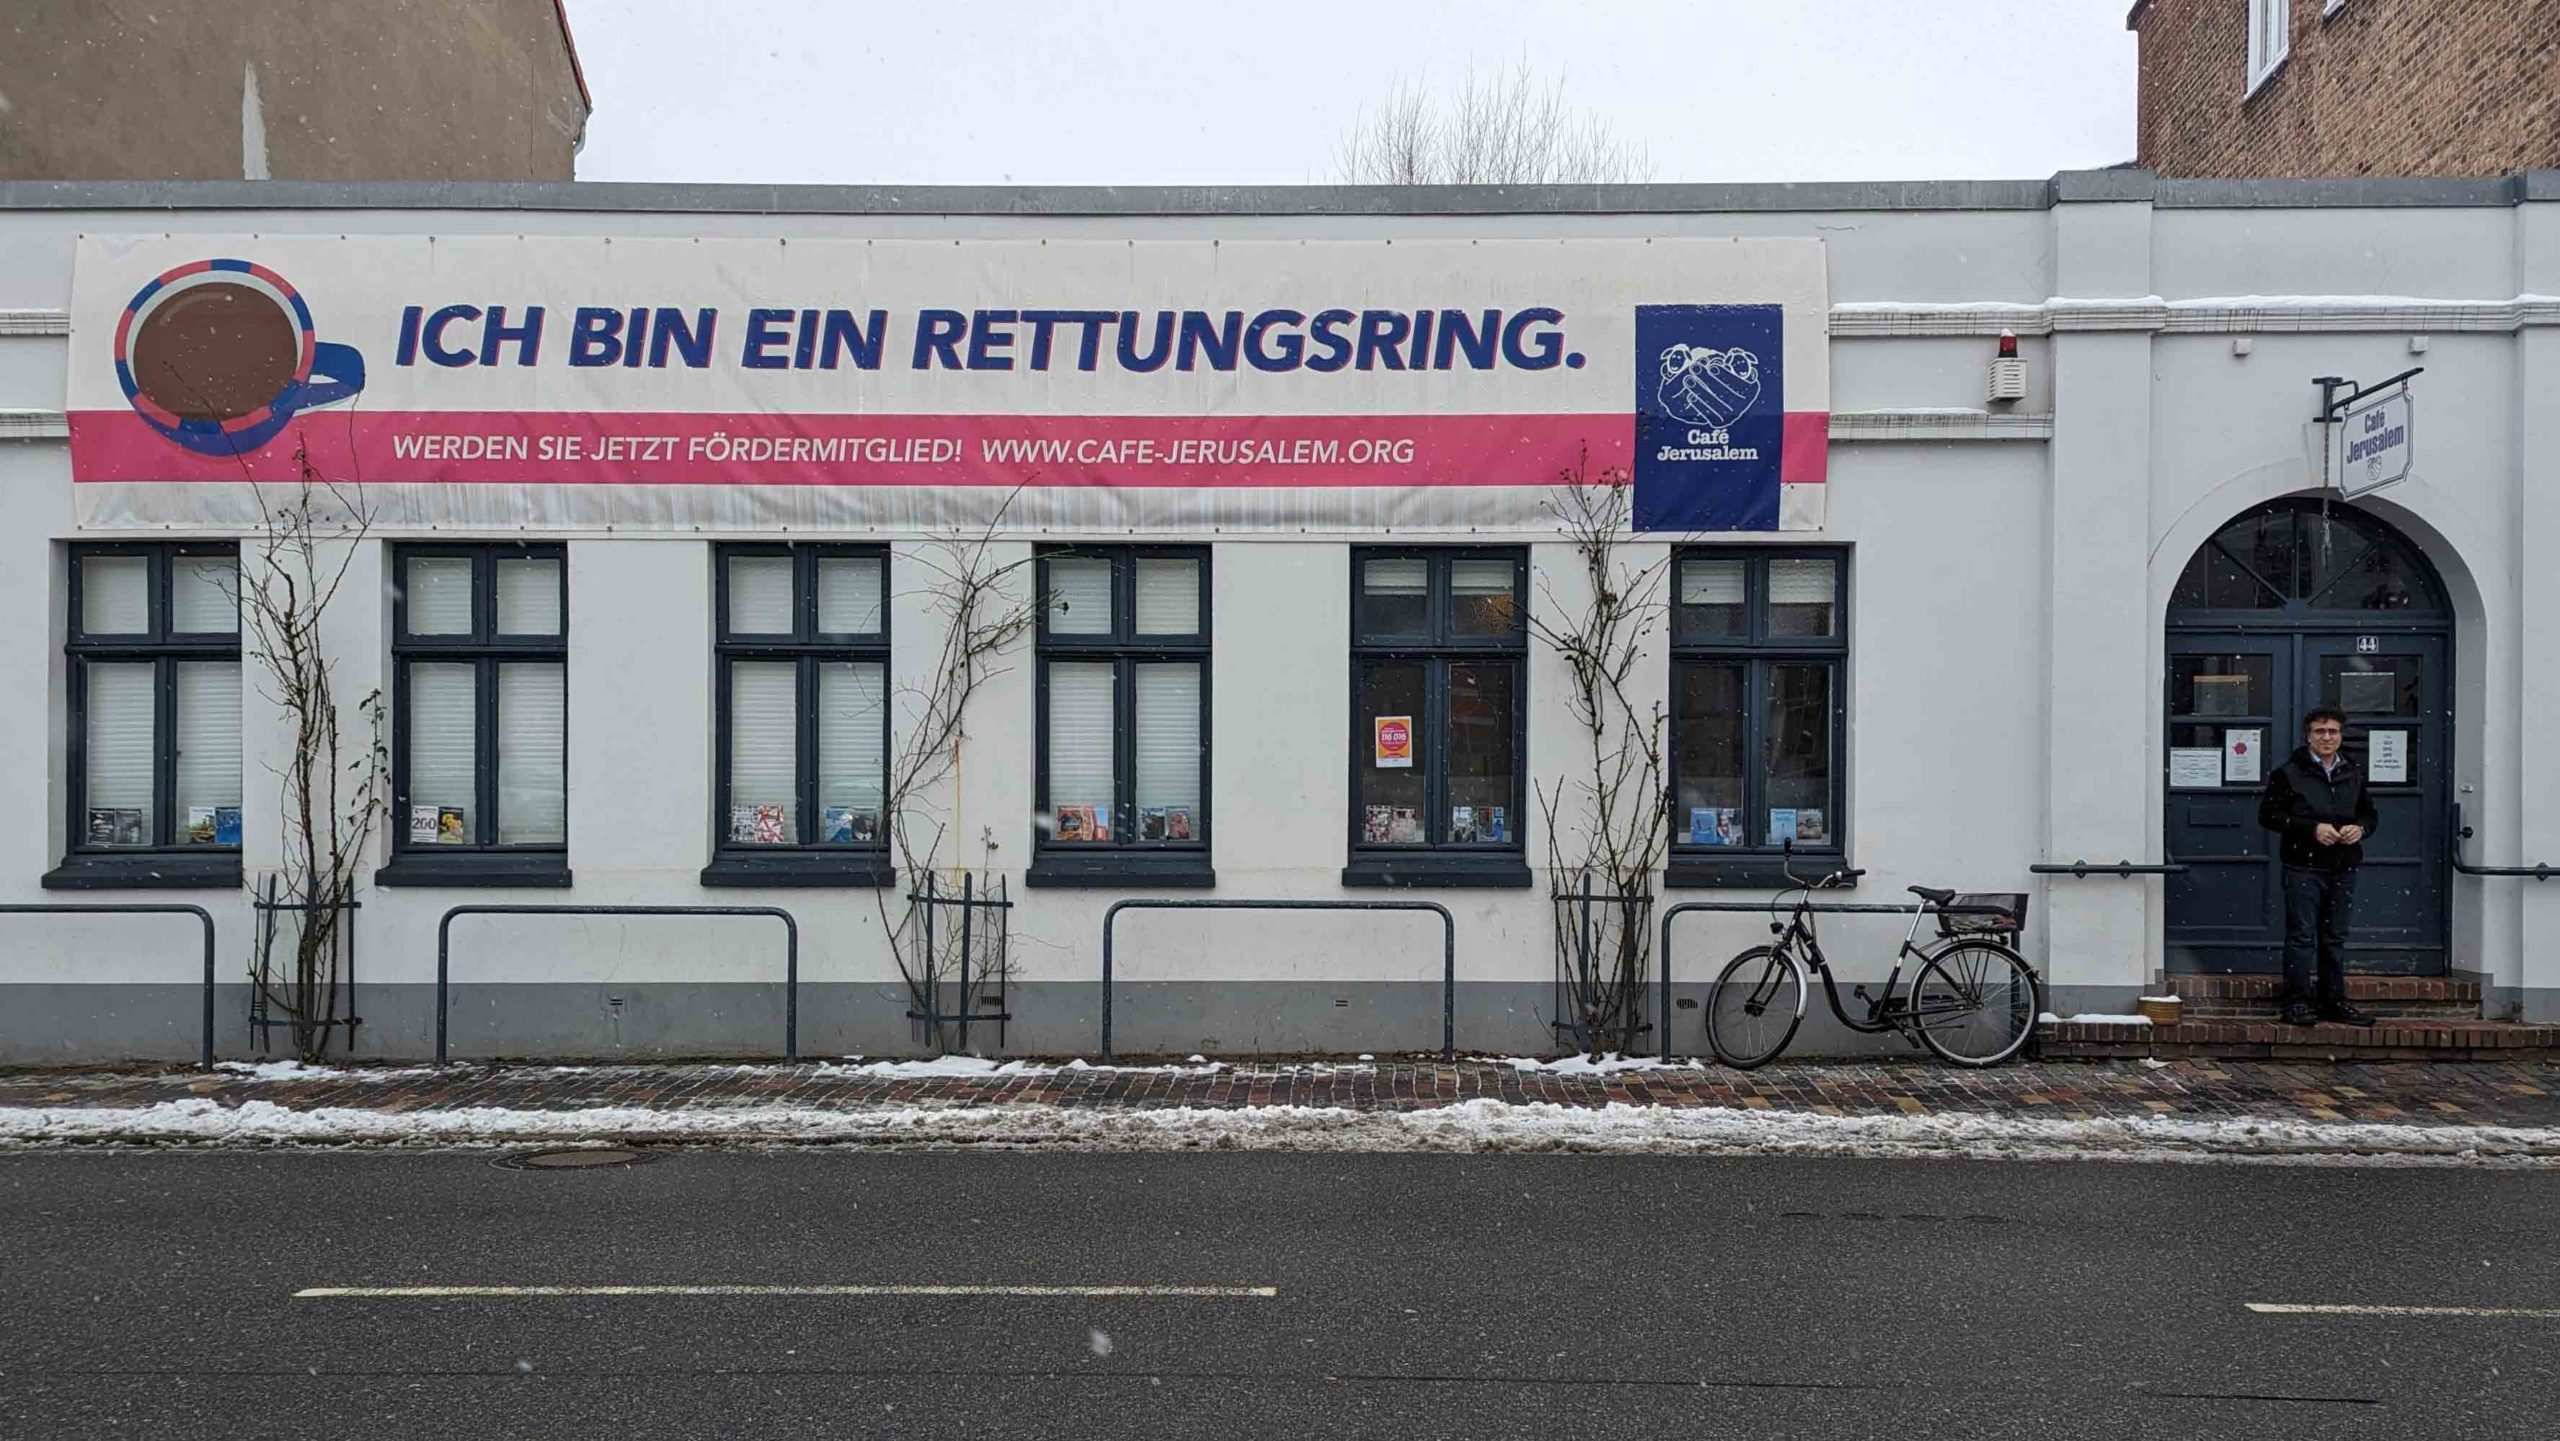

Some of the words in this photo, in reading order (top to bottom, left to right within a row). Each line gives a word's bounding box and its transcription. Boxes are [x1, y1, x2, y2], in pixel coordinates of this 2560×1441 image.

[395, 304, 545, 367] ICH
[569, 307, 718, 368] BIN
[741, 309, 886, 370] EIN
[913, 309, 1587, 372] RETTUNGSRING.
[2364, 406, 2386, 434] Café
[393, 435, 528, 460] WERDEN
[537, 435, 582, 461] SIE
[589, 436, 681, 461] JETZT
[687, 432, 963, 463] FÖRDERMITGLIED!
[981, 439, 1416, 464] WWW.CAFE-JERUSALEM.ORG
[1687, 428, 1730, 444] Café
[2346, 424, 2405, 464] Jerusalem
[1657, 445, 1759, 461] Jerusalem
[2359, 637, 2376, 651] 44
